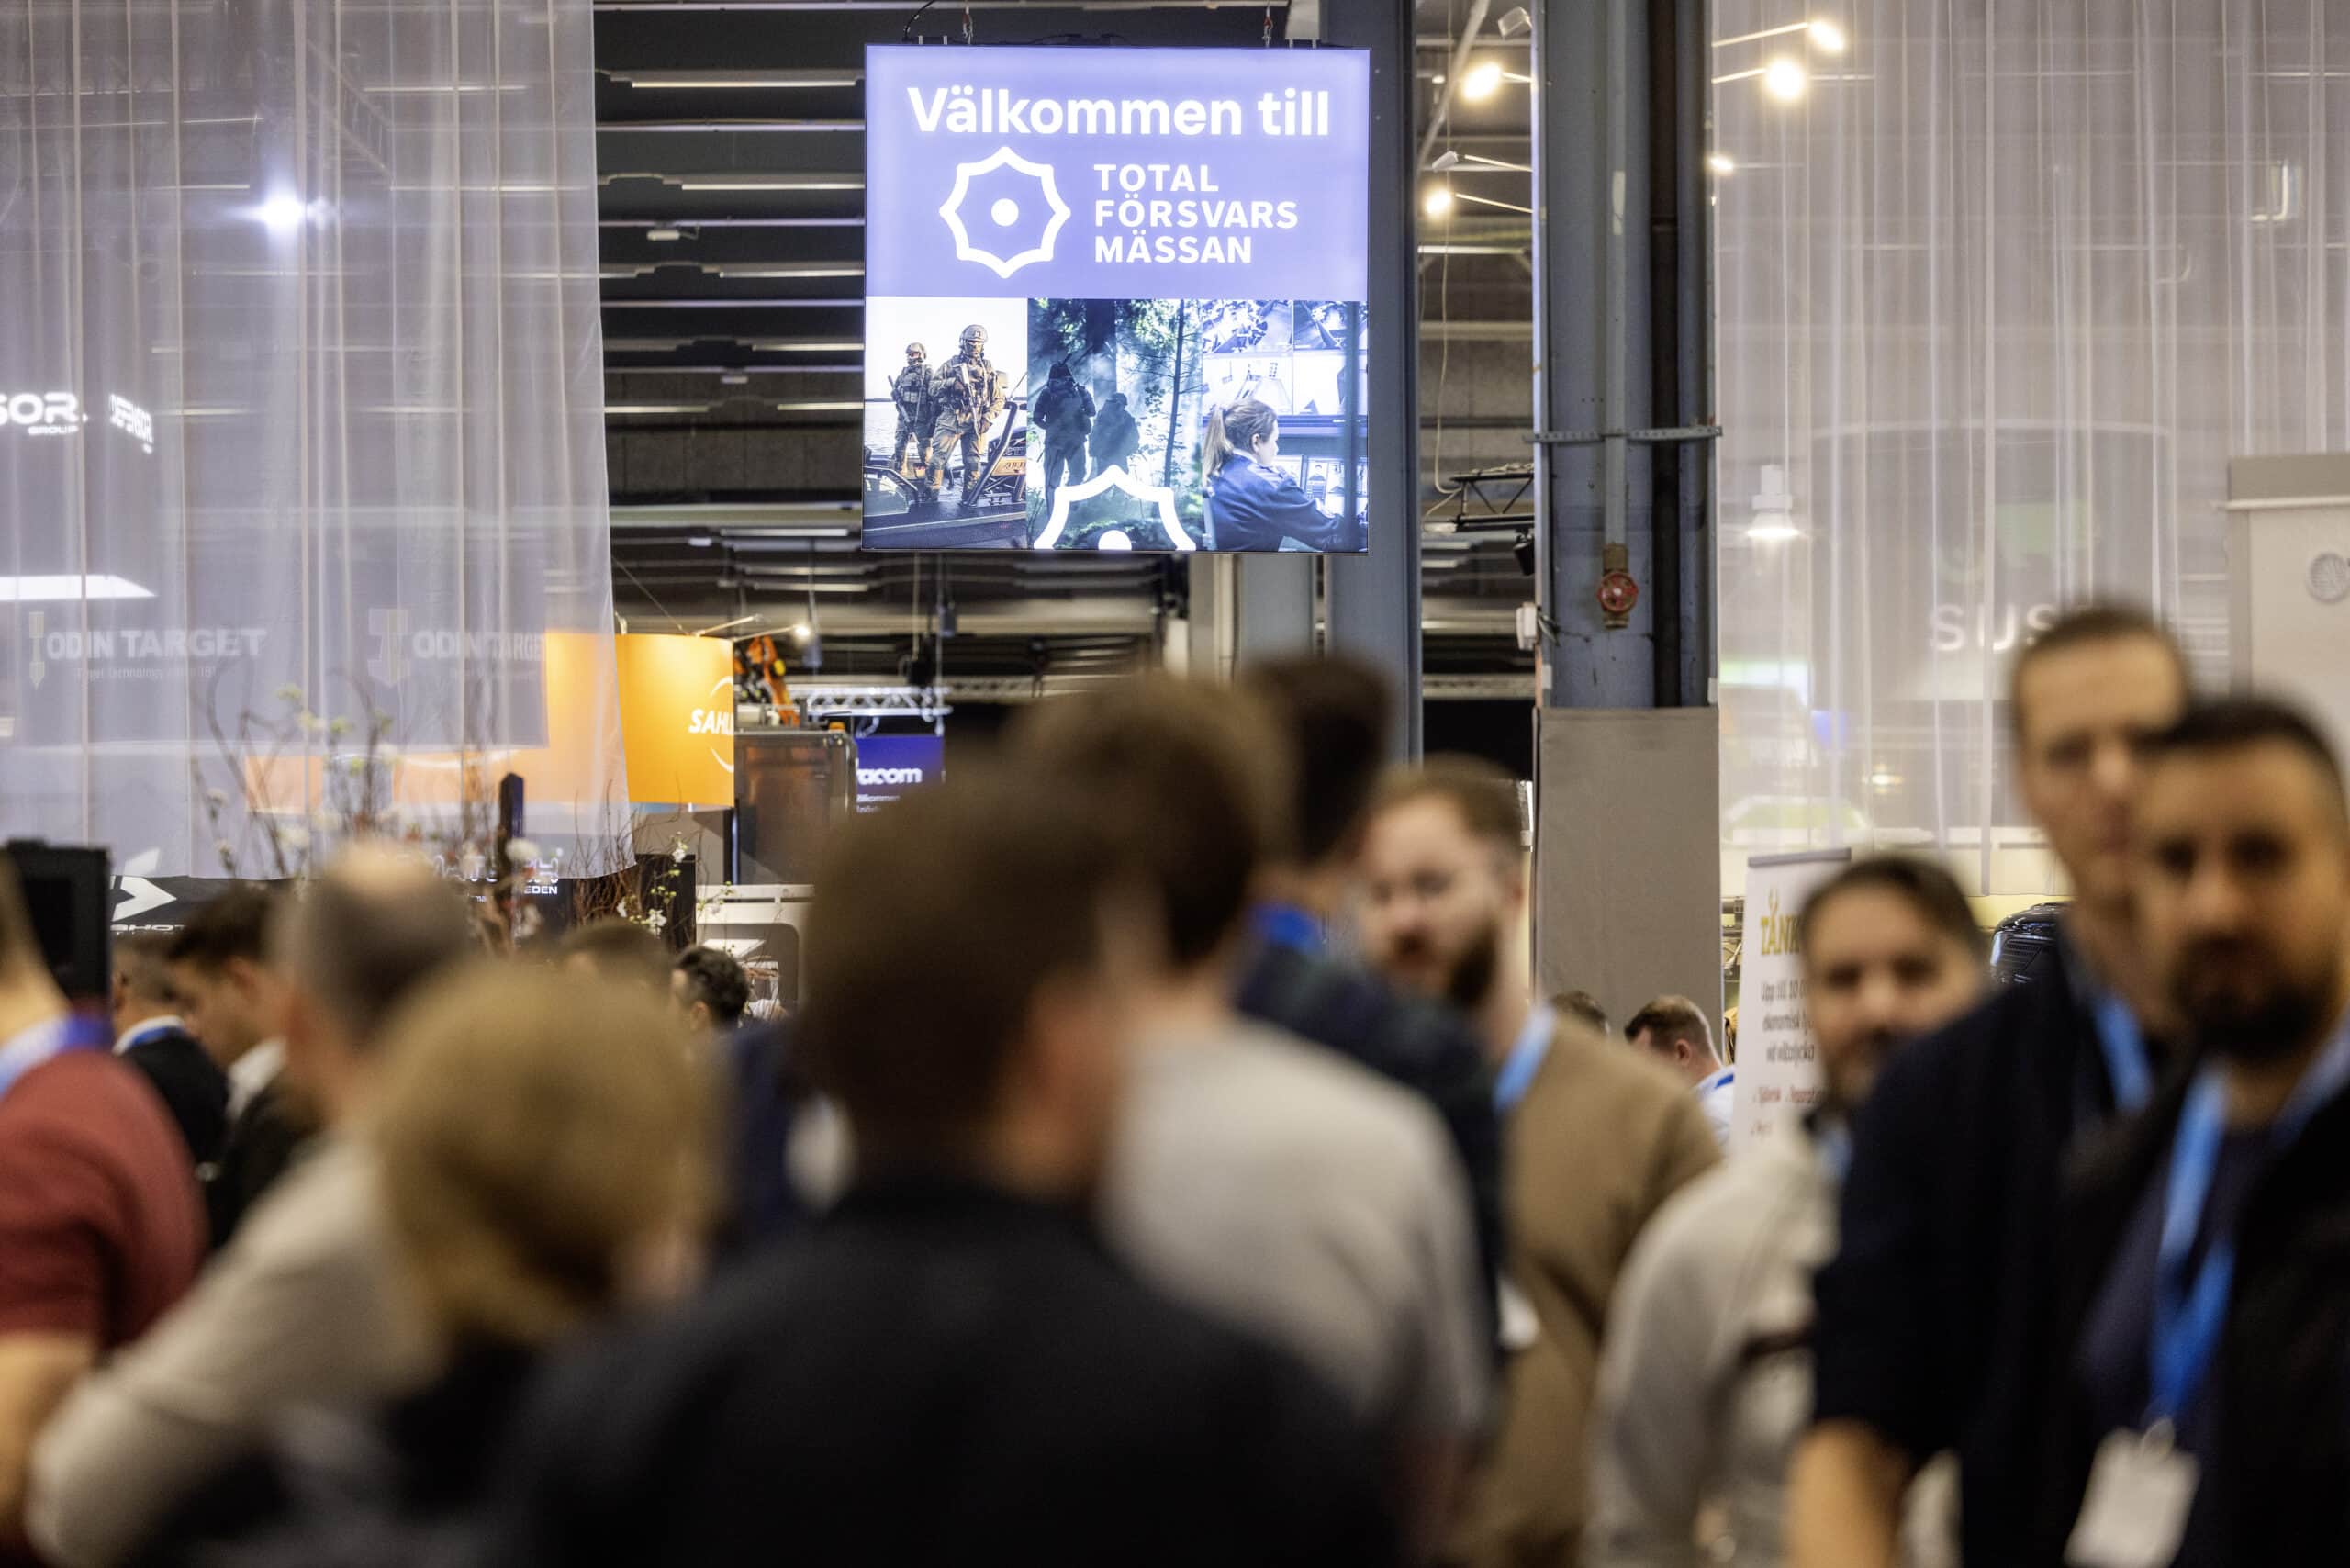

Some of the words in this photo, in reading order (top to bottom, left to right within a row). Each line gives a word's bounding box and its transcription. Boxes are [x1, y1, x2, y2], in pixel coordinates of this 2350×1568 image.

[907, 84, 1242, 135] Välkommen
[1258, 87, 1329, 136] till
[1093, 163, 1219, 192] TOTAL
[1094, 192, 1299, 229] FÖRSVARS
[1094, 229, 1252, 263] MÄSSAN
[46, 631, 113, 660] ODIN
[120, 628, 267, 659] TARGET
